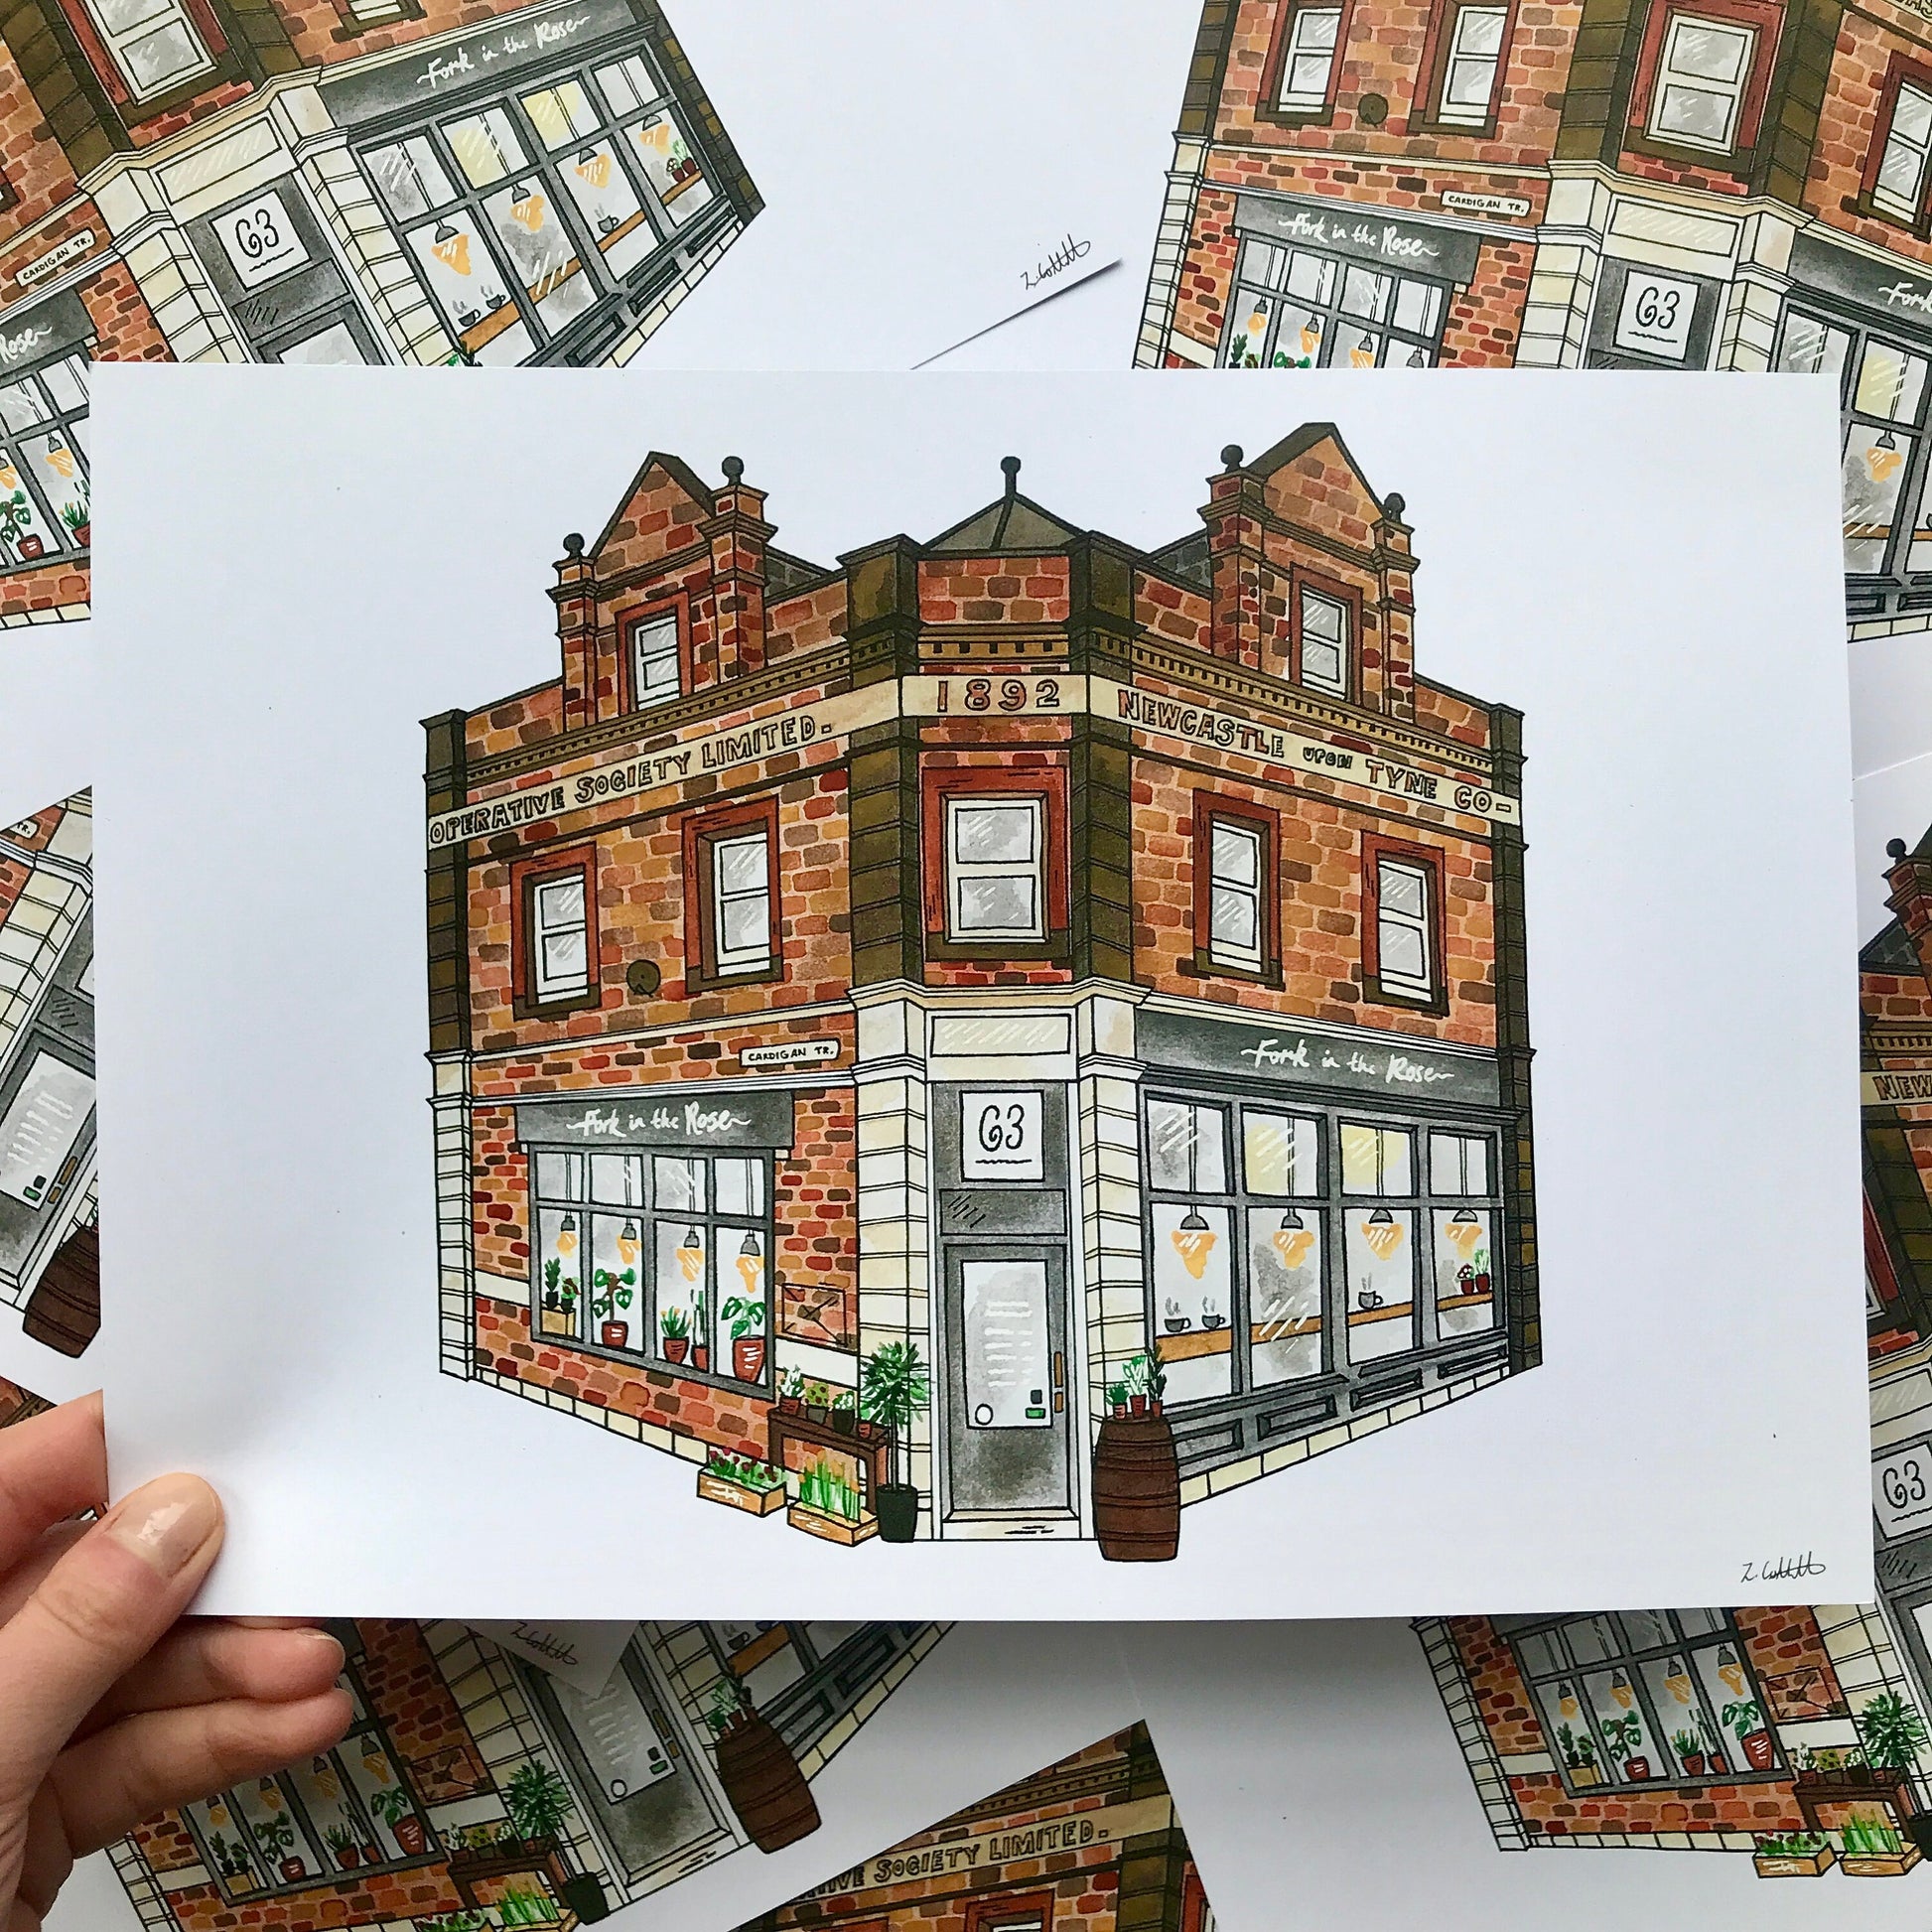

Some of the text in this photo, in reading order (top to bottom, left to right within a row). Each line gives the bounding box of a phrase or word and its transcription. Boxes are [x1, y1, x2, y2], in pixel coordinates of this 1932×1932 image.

[1447, 196, 1525, 213] CARDIGAN TR.
[1278, 212, 1328, 243] Fork
[1331, 225, 1347, 239] in
[1351, 224, 1377, 247] the
[23, 237, 91, 280] CARDIGAN TR.
[936, 677, 1060, 714] 1892
[1118, 688, 1285, 759] NEWCASTLE
[1303, 747, 1352, 769] UPON
[1365, 759, 1438, 800] TYNE
[429, 715, 832, 844] OPERATIVE SOCIETY LIMITED.
[747, 1045, 835, 1062] CARDIGAN TR.
[1241, 1038, 1311, 1069] Fork
[566, 1108, 627, 1138] Fork
[628, 1114, 645, 1131] in
[650, 1107, 679, 1131] the
[874, 1843, 981, 1883] SOCIETY
[989, 1819, 1109, 1861] LIMITED.
